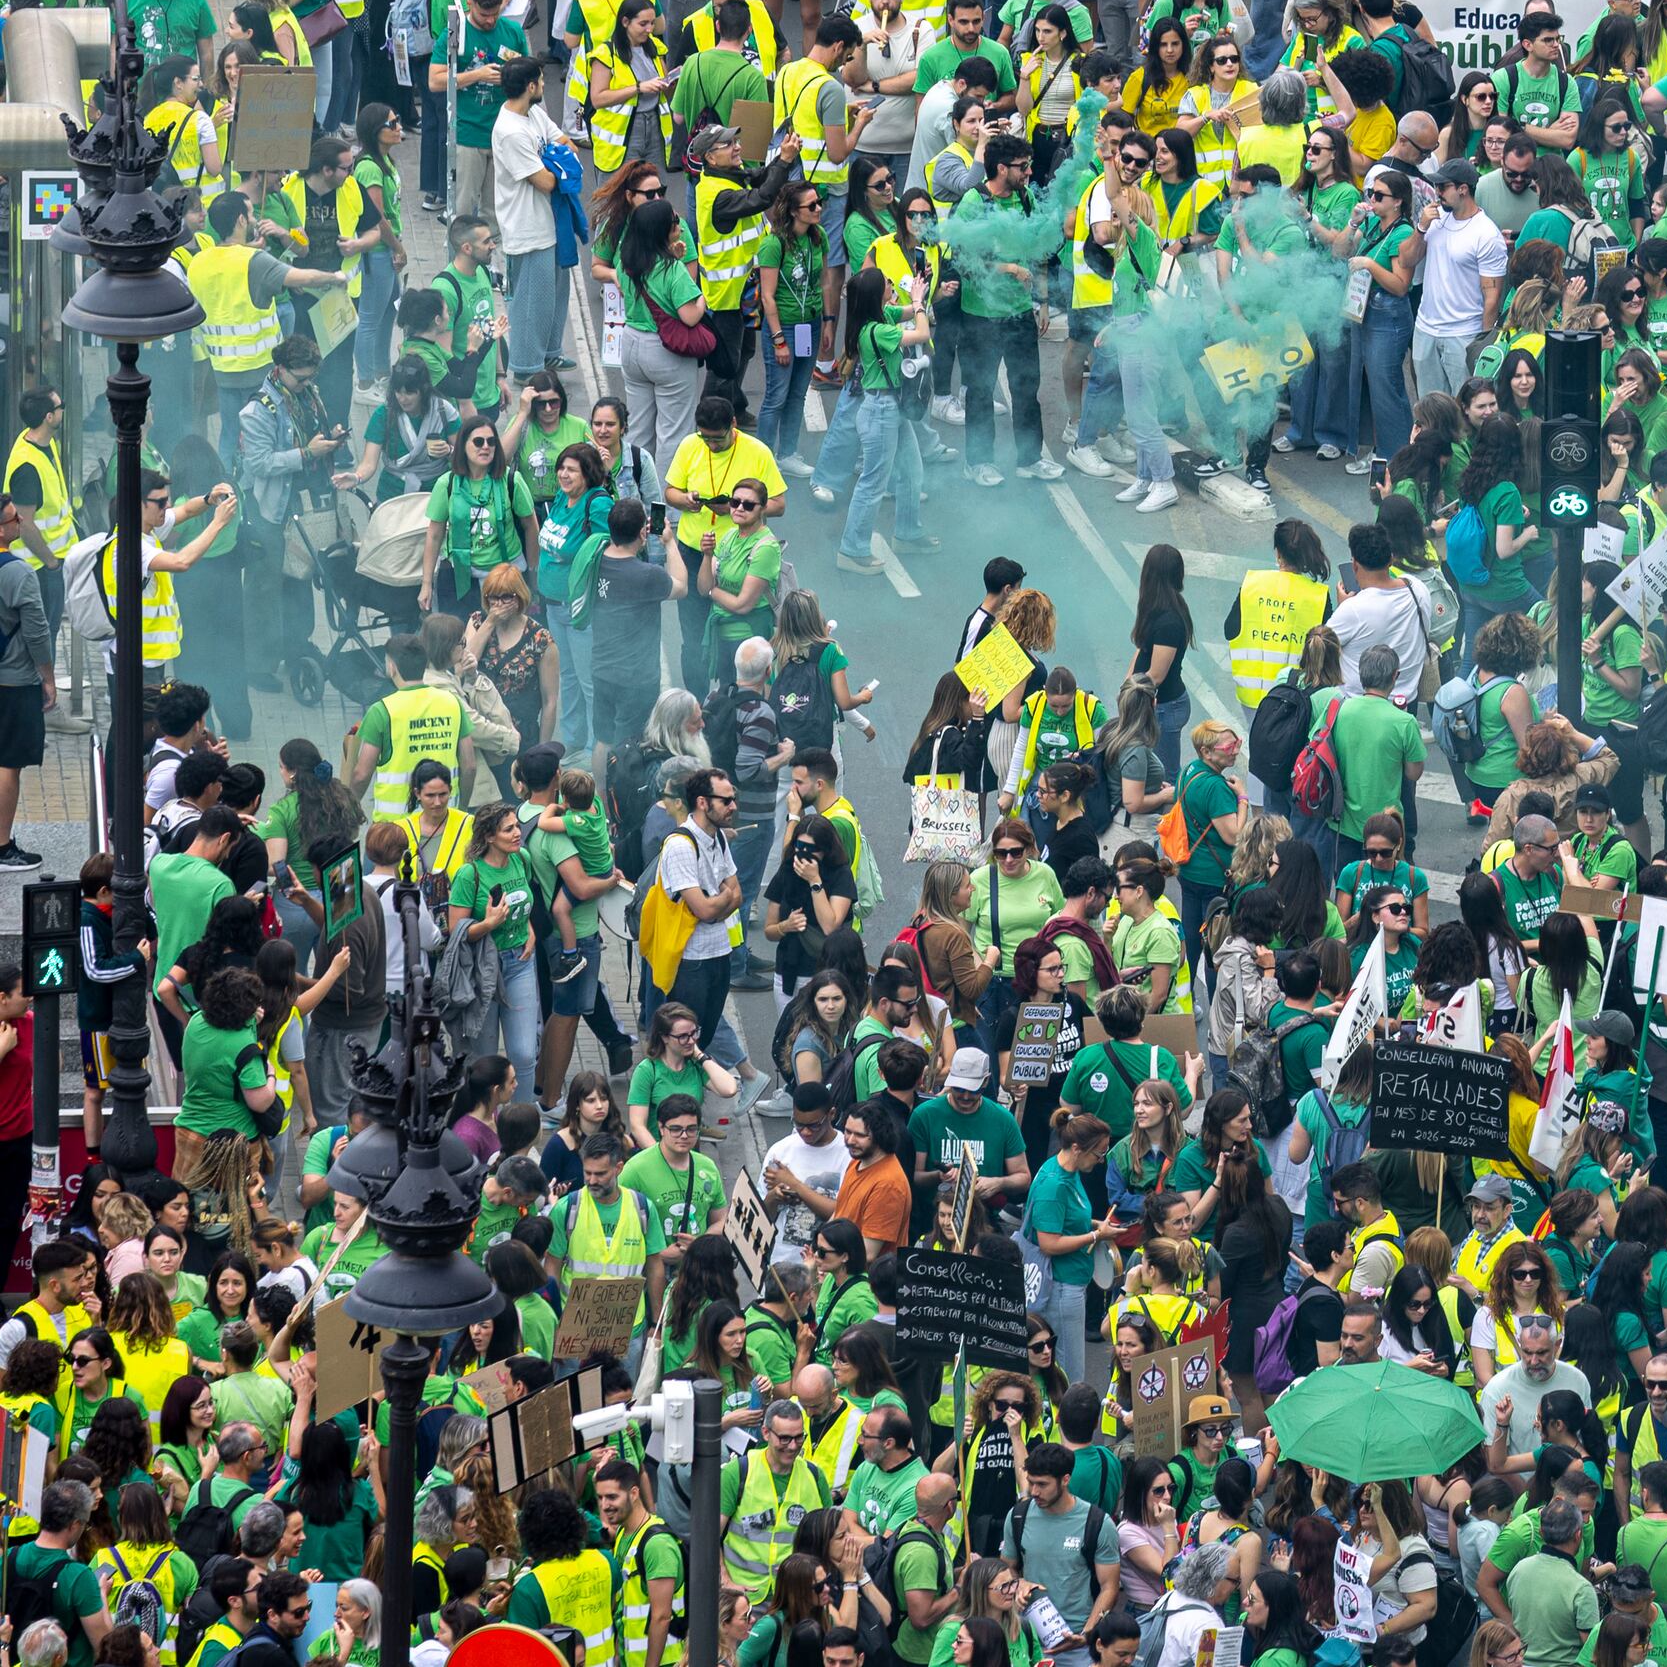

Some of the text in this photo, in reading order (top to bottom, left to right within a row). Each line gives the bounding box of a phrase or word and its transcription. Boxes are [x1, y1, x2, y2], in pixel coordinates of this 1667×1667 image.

[592, 1283, 639, 1304] GOTERES
[594, 1306, 634, 1325] SAUNES
[559, 1333, 588, 1354] MÉS
